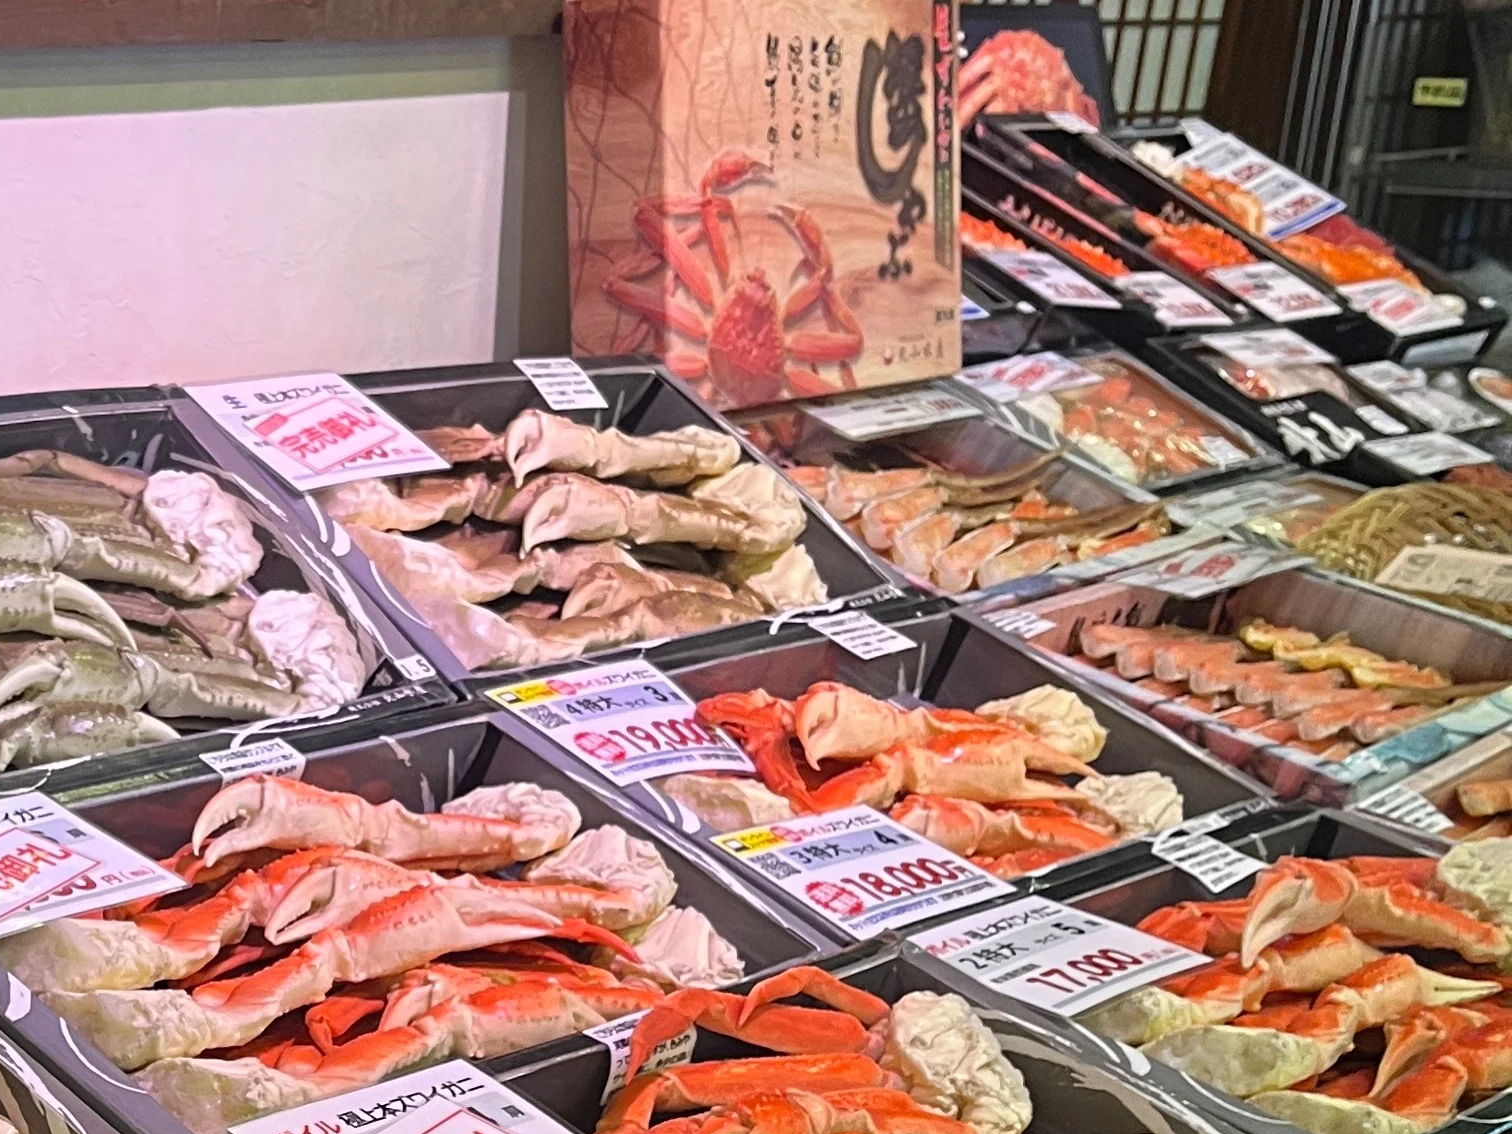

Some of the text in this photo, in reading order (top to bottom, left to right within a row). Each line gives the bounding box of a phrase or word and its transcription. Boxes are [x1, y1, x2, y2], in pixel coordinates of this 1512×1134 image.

[400, 658, 431, 677] 1.5
[642, 685, 669, 704] 3
[873, 830, 898, 845] 4
[840, 857, 958, 902] 18,000
[1054, 919, 1087, 936] 5
[1025, 949, 1144, 994] 17,000
